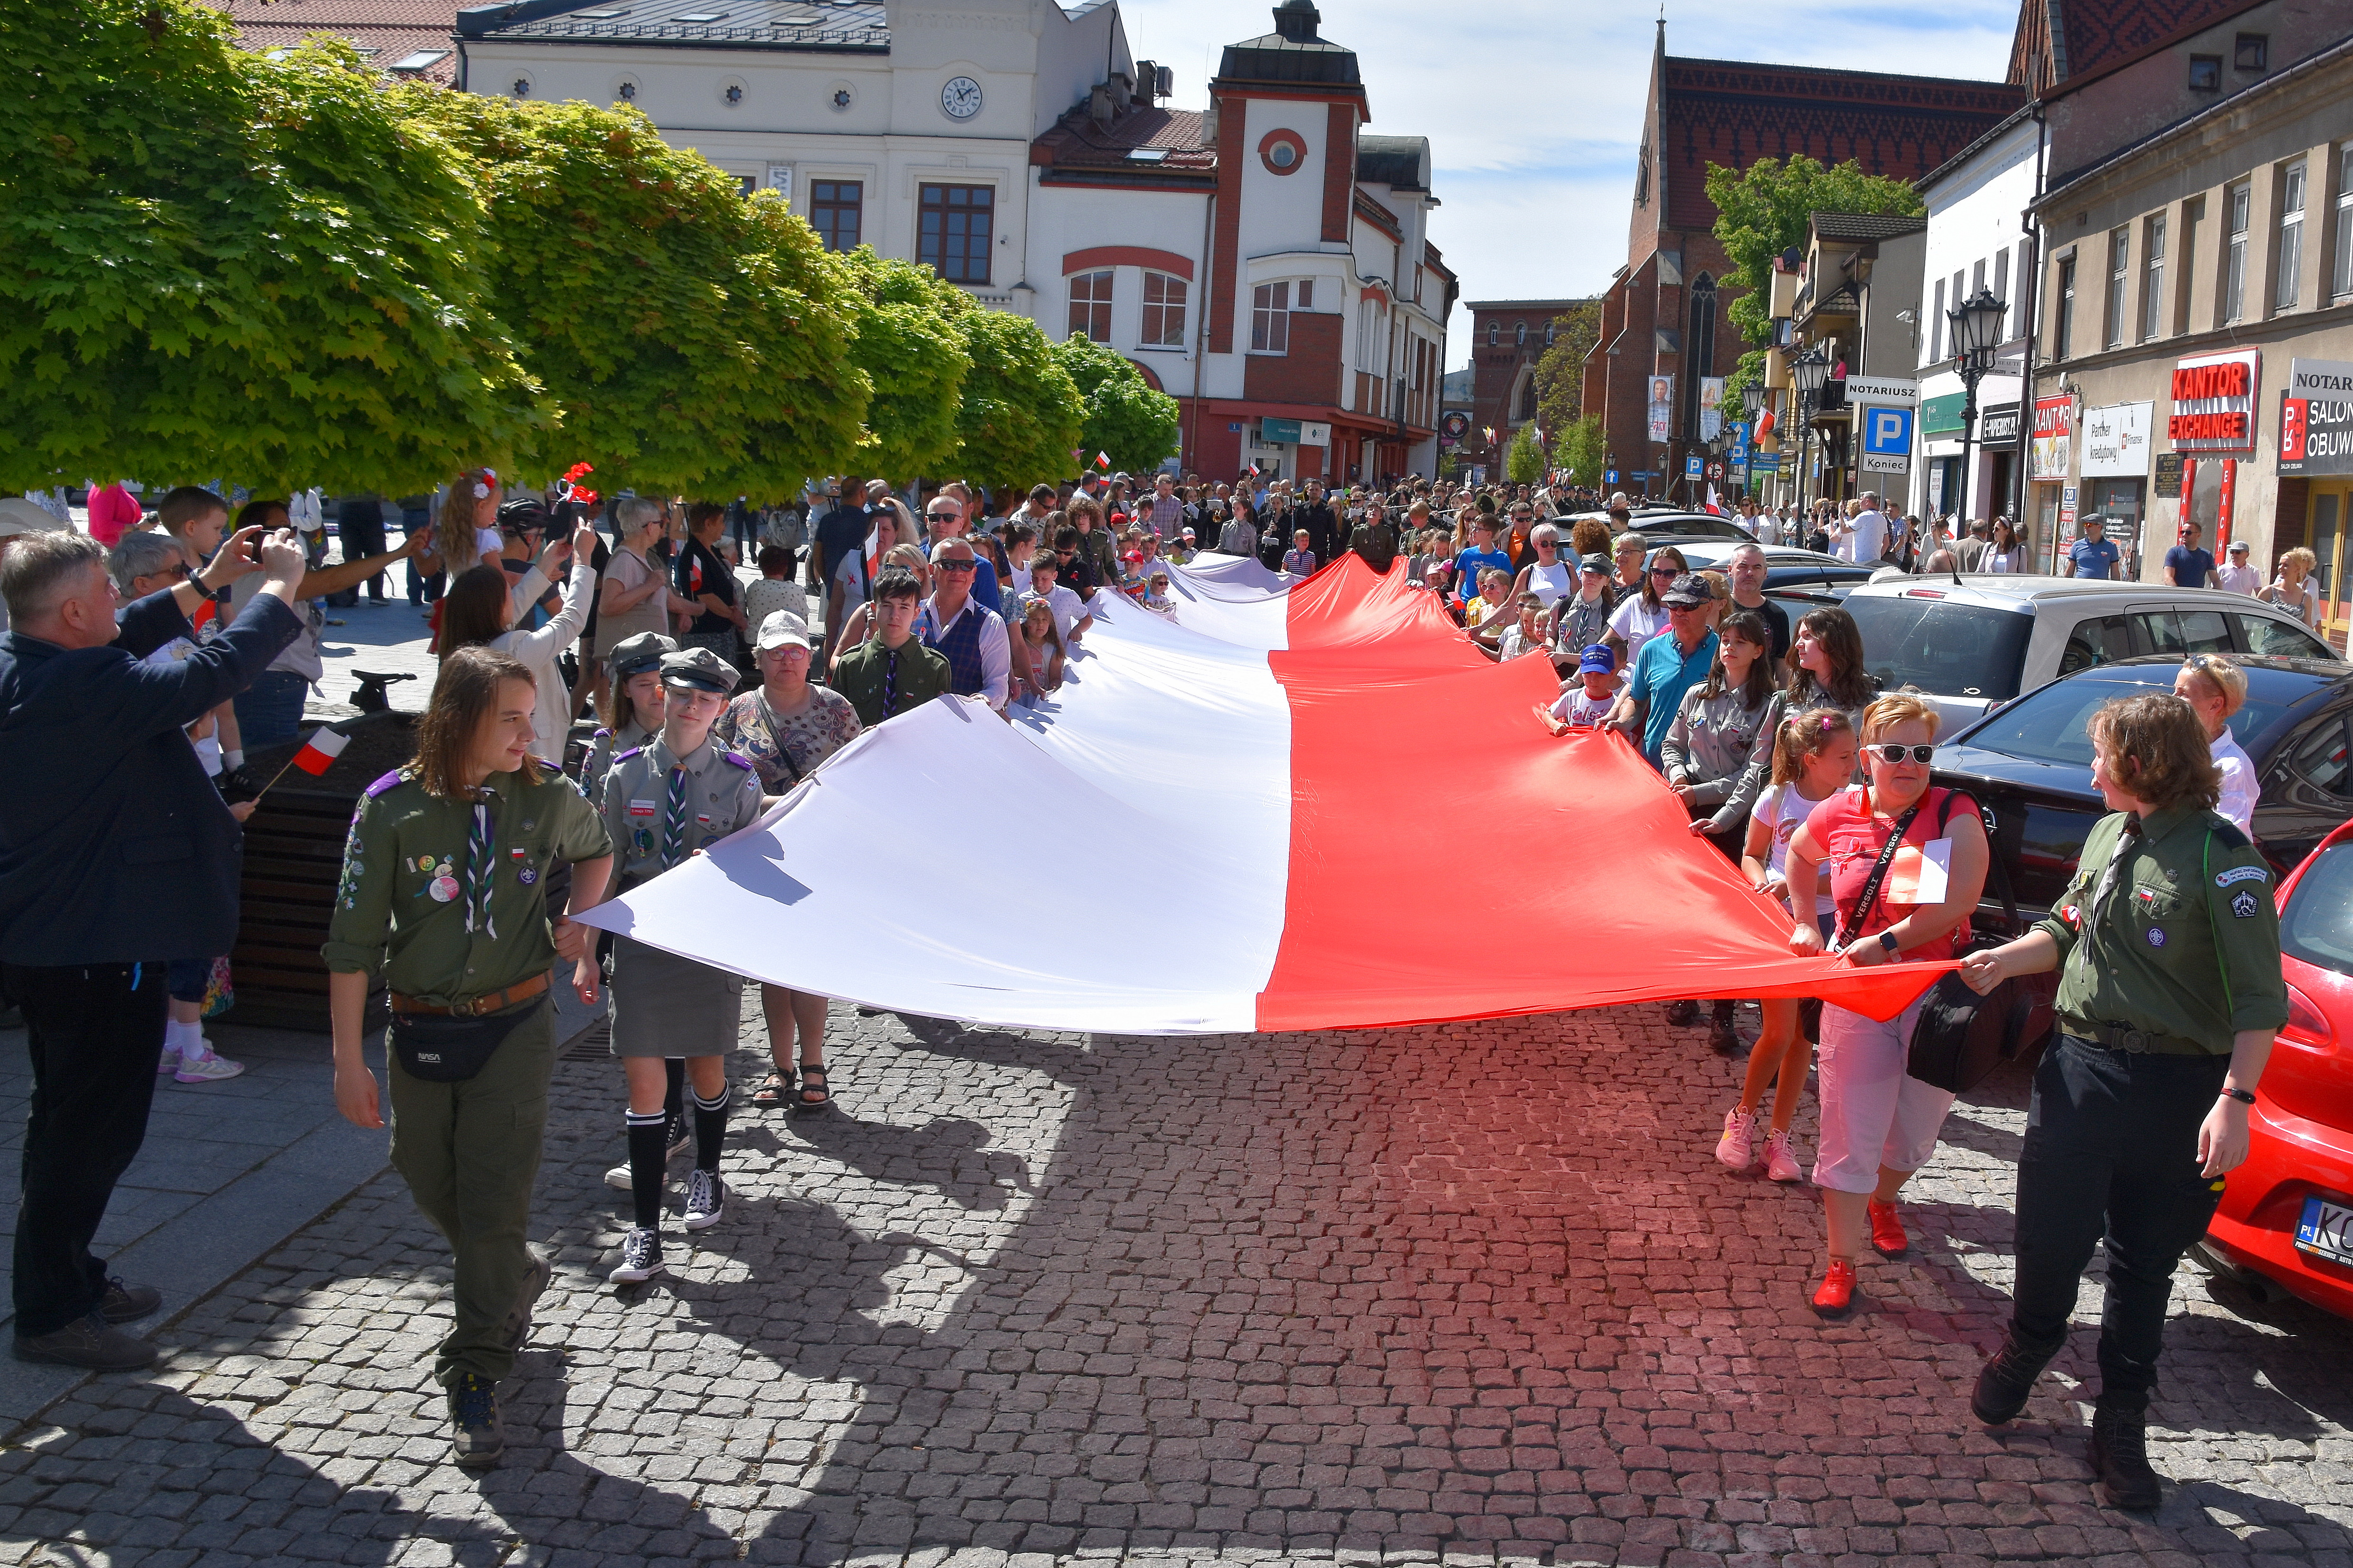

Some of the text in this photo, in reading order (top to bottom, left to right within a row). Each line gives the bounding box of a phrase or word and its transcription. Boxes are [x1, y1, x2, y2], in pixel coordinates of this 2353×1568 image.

[1849, 385, 1915, 397] NOTARIUSZ
[2171, 362, 2245, 400] KANTOR
[1983, 416, 2016, 438] E-PAPIEROSY.PL
[2034, 404, 2070, 432] KANTOR
[2168, 412, 2245, 440] EXCHANGE
[1875, 414, 1902, 448] P
[2092, 424, 2111, 438] Partner
[1867, 459, 1904, 469] Koniec
[2090, 444, 2117, 463] kredytowy
[2066, 489, 2074, 500] 20
[1879, 826, 1904, 865] VERSOLI
[1855, 876, 1879, 918] VERSOLI
[418, 1053, 441, 1061] NASA
[2300, 1224, 2312, 1237] PL
[2294, 1241, 2352, 1265] PROFIAUTOSERWIS AUTO
